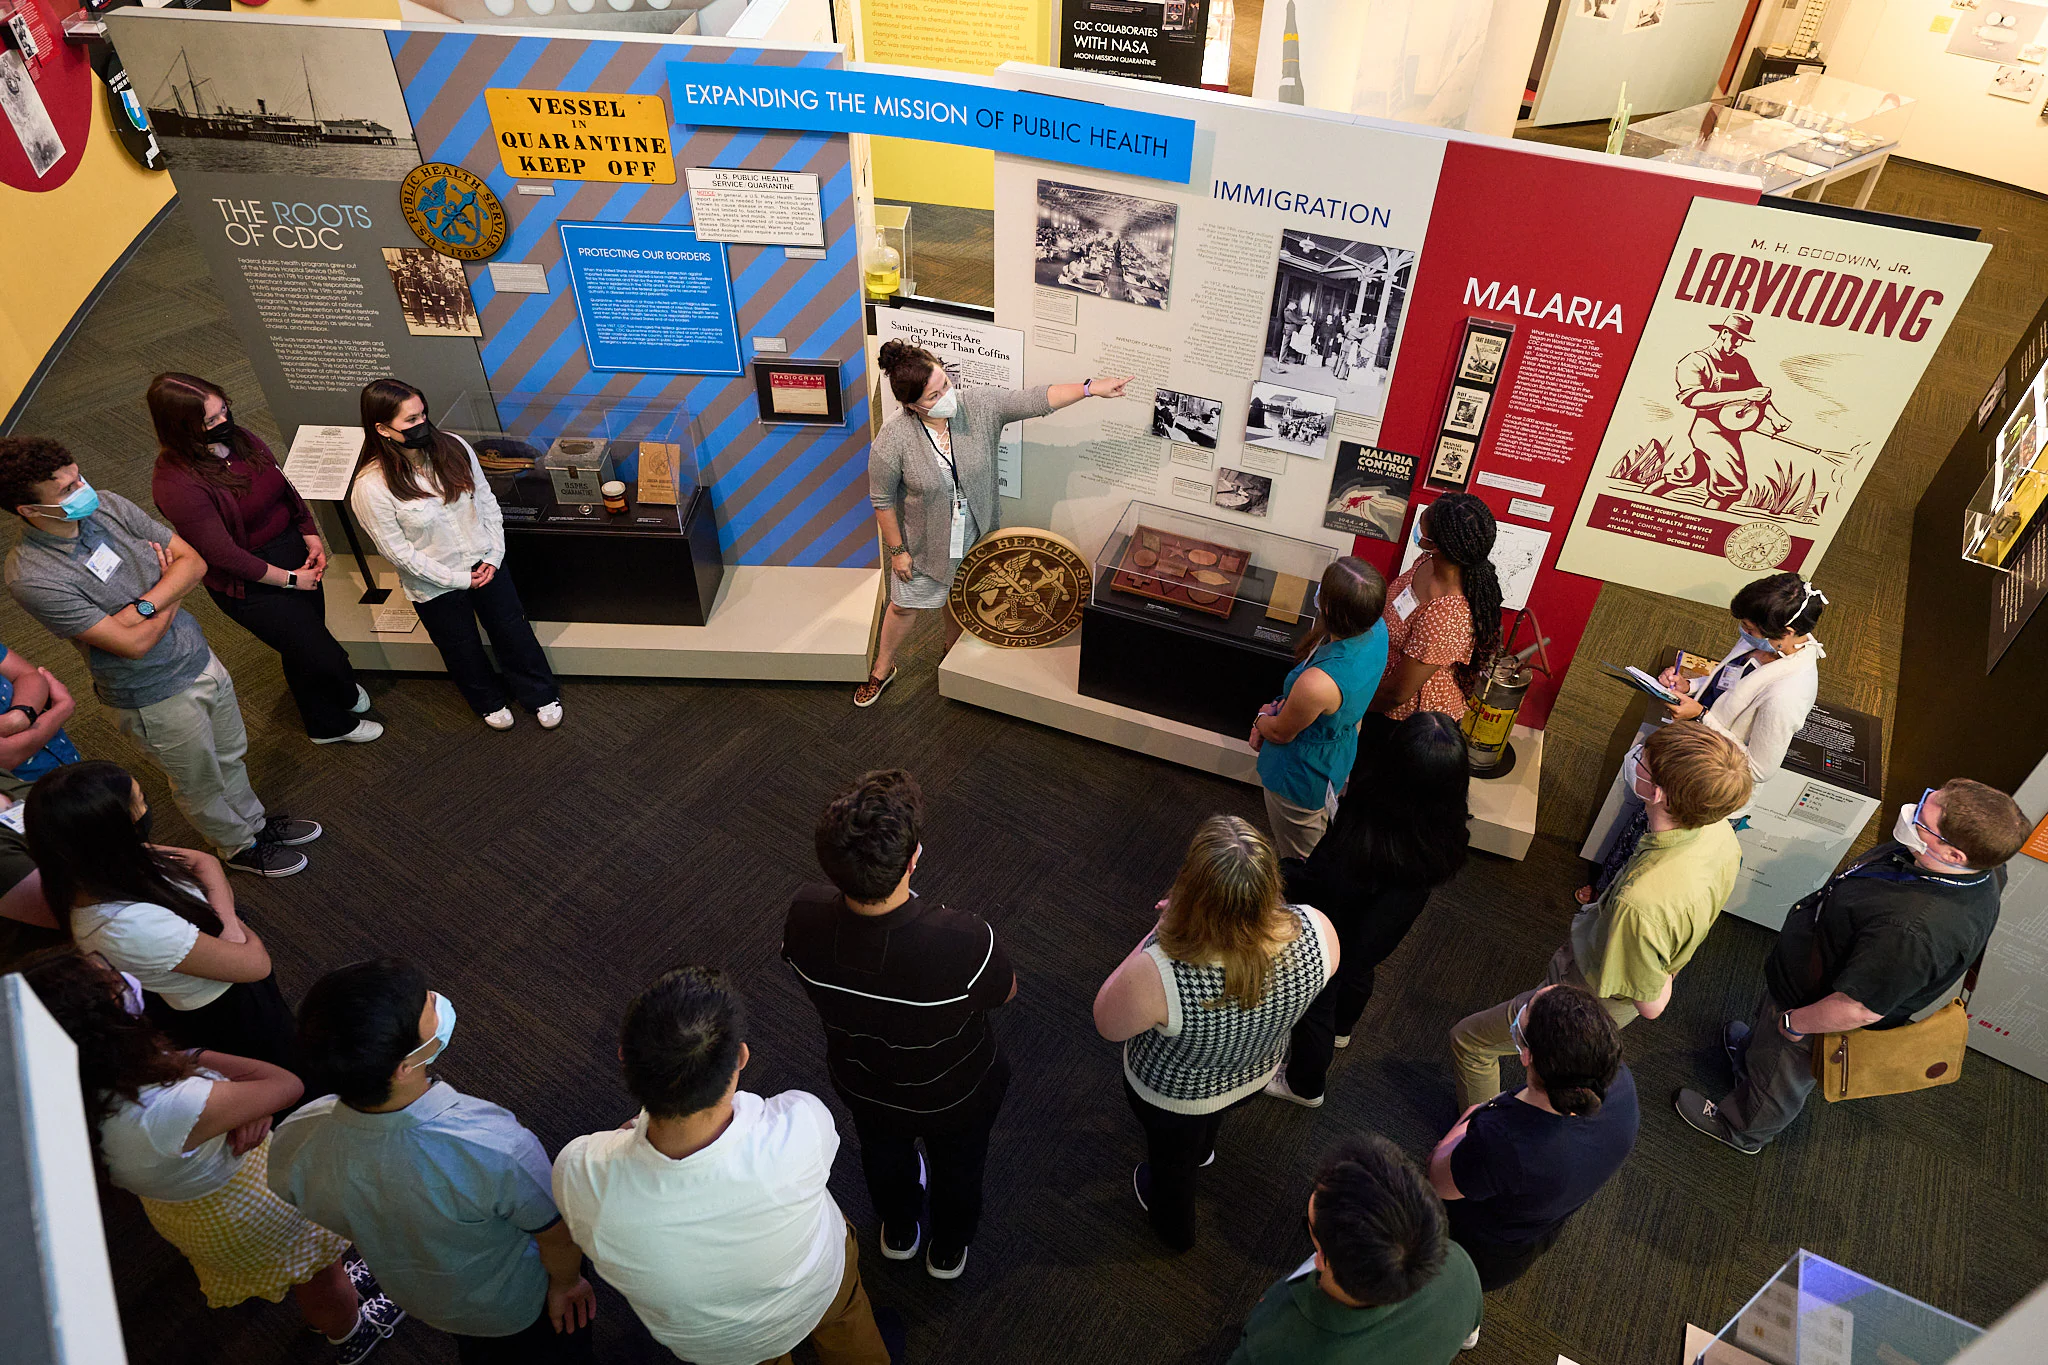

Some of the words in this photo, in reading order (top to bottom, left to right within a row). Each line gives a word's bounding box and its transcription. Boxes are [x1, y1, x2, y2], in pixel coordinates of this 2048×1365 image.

[1074, 21, 1093, 31] CDC
[1095, 22, 1158, 37] COLLABORATES
[1074, 34, 1108, 50] WITH
[1112, 38, 1149, 54] NASA
[1120, 57, 1156, 66] QUARANTINE
[527, 97, 625, 118] VESSEL
[572, 120, 586, 128] IN
[686, 84, 818, 110] EXPANDING
[826, 91, 866, 114] THE
[874, 96, 968, 126] MISSION
[976, 108, 1006, 130] OF
[1013, 112, 1081, 143] PUBLIC
[1089, 123, 1168, 158] HEALTH
[502, 132, 666, 154] QUARANTINE
[518, 156, 586, 174] KEEP
[608, 160, 656, 176] OFF
[212, 198, 268, 224] THE
[272, 201, 372, 228] ROOTS
[404, 174, 420, 225] PUBLIC
[422, 166, 482, 190] HEALTH
[483, 192, 504, 250] SERVICE
[1214, 180, 1391, 228] IMMIGRATION
[225, 223, 264, 246] OF
[272, 225, 343, 250] CDC
[450, 249, 481, 258] 1798
[578, 248, 640, 258] PROTECTING
[642, 250, 664, 260] OUR
[666, 251, 711, 262] BORDERS
[1750, 238, 1768, 250] M.
[1774, 242, 1790, 254] H.
[1798, 246, 1882, 272] GOODWIN,
[1888, 262, 1912, 275] JR.
[1462, 276, 1623, 334] MALARIA
[1674, 248, 1944, 343] LARVICIDING
[891, 320, 928, 337] Sanitary
[932, 328, 962, 342] Privies
[964, 334, 981, 344] Are
[1560, 334, 1582, 342] become
[910, 334, 948, 349] Cheaper
[950, 342, 975, 354] Than
[978, 346, 1010, 360] Coffins
[1358, 456, 1410, 476] CONTROL
[1360, 447, 1413, 466] MALARIA
[1385, 472, 1409, 480] AREAS
[1630, 503, 1652, 512] FEDERAL
[1654, 508, 1678, 516] SECURITY
[1680, 514, 1702, 522] AGENCY
[1610, 516, 1634, 525] MALARIA
[1638, 522, 1663, 532] CONTROL
[1632, 512, 1654, 520] PUBLIC
[1657, 518, 1683, 527] HEALTH
[1686, 524, 1712, 534] SERVICE
[1634, 530, 1656, 538] GEORGIA
[1666, 538, 1690, 546] OCTOBER
[1728, 526, 1748, 548] PUBLIC
[1752, 524, 1786, 538] HEALTH
[952, 548, 989, 602] PUBLIC
[995, 536, 1077, 564] HEALTH
[1004, 637, 1038, 646] 1798
